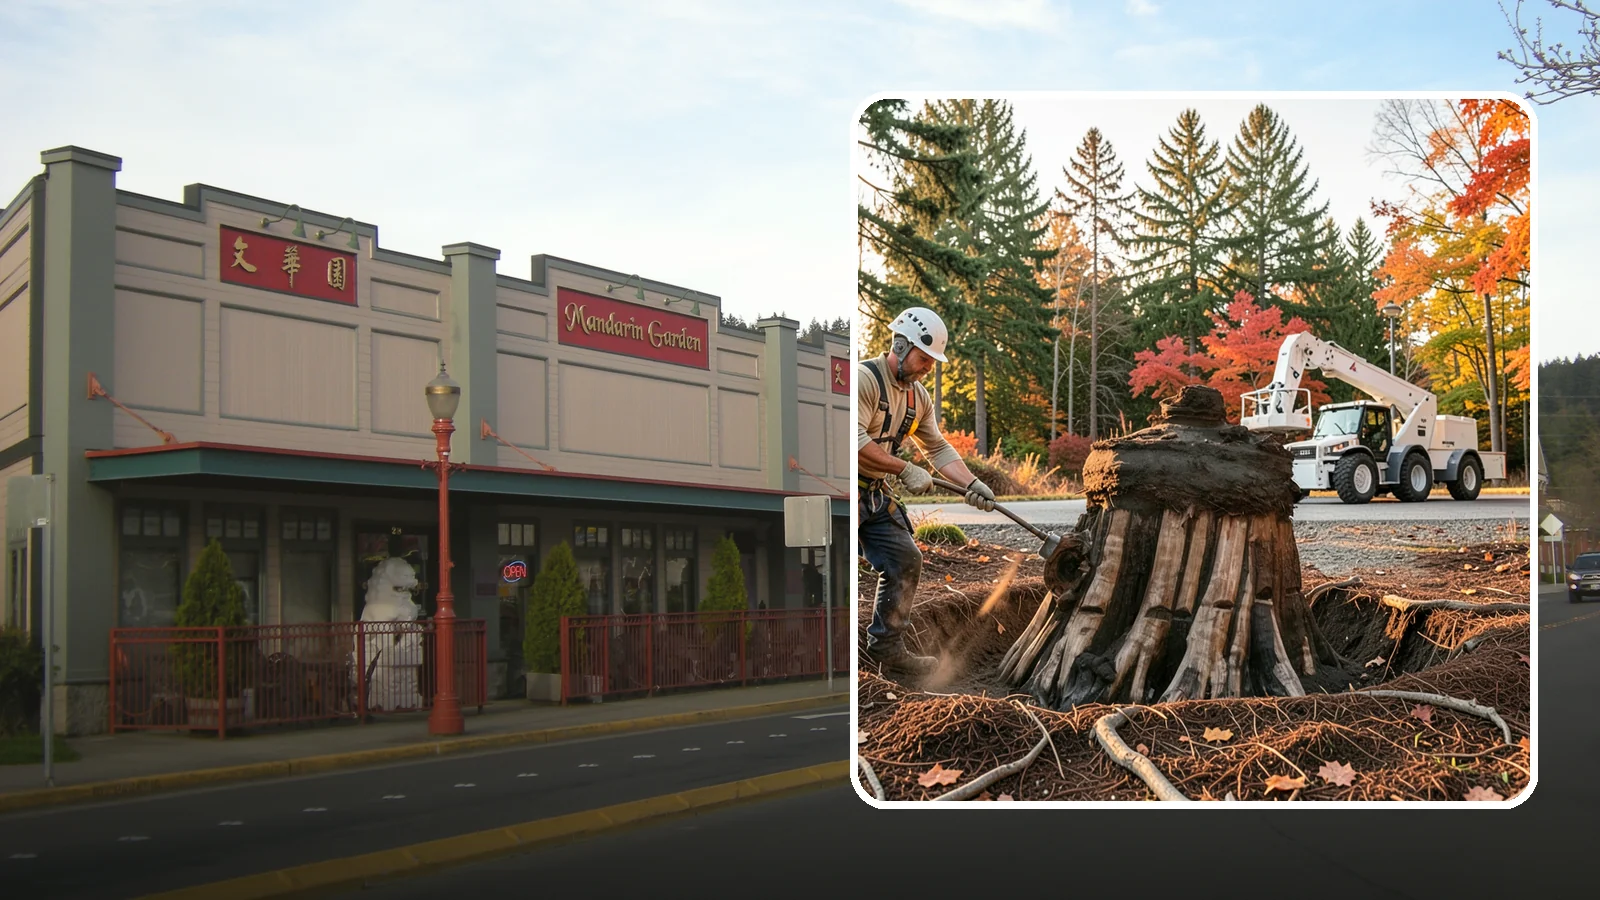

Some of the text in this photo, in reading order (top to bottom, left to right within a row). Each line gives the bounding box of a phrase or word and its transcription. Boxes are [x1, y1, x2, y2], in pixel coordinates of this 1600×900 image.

[231, 236, 346, 291] 文華園
[564, 302, 702, 353] Mandarin Garden
[835, 363, 846, 386] 文
[503, 565, 527, 578] OPEN
